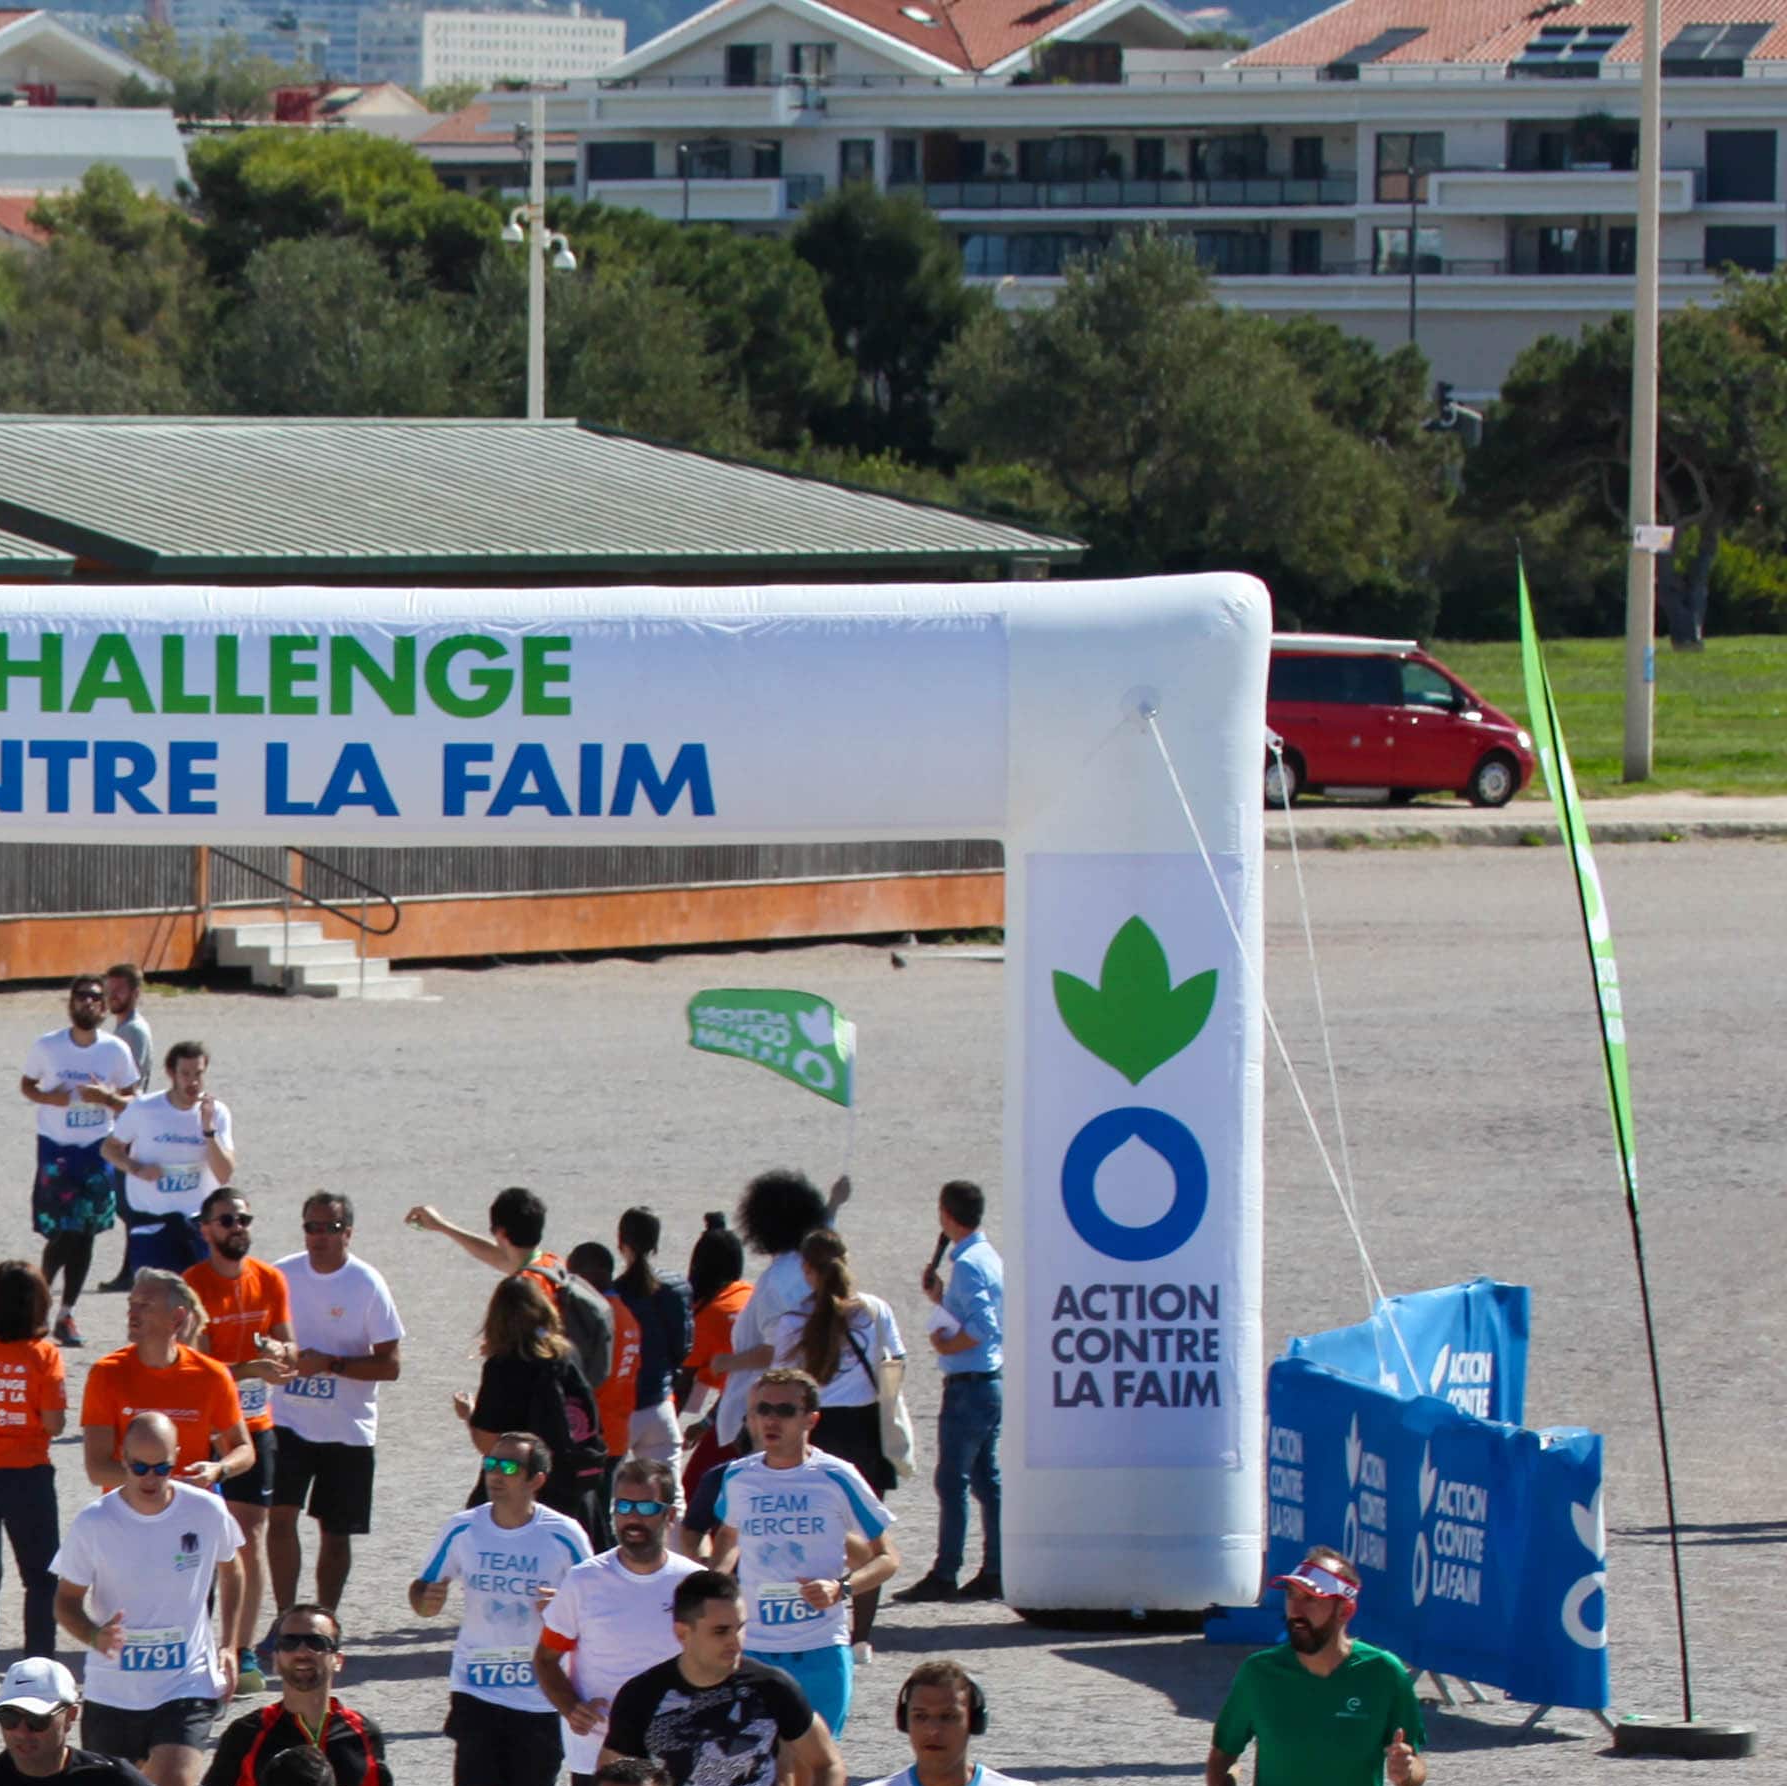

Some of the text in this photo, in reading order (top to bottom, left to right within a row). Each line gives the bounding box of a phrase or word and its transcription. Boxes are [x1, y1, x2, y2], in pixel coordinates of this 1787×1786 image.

[263, 741, 400, 818] LA
[441, 741, 717, 818] FAIM
[1052, 1283, 1220, 1322] ACTION
[1052, 1327, 1220, 1365] CONTRE
[1448, 1352, 1493, 1384] ACTION
[1052, 1370, 1222, 1408] LA FAIM
[1270, 1424, 1304, 1465] ACTION
[749, 1494, 809, 1515] TEAM
[1435, 1479, 1488, 1523] ACTION
[1433, 1519, 1485, 1564] CONTRE
[478, 1551, 539, 1576] TEAM
[1432, 1559, 1482, 1607] LA FAIM
[123, 1645, 185, 1669] 1791
[468, 1663, 533, 1687] 1766
